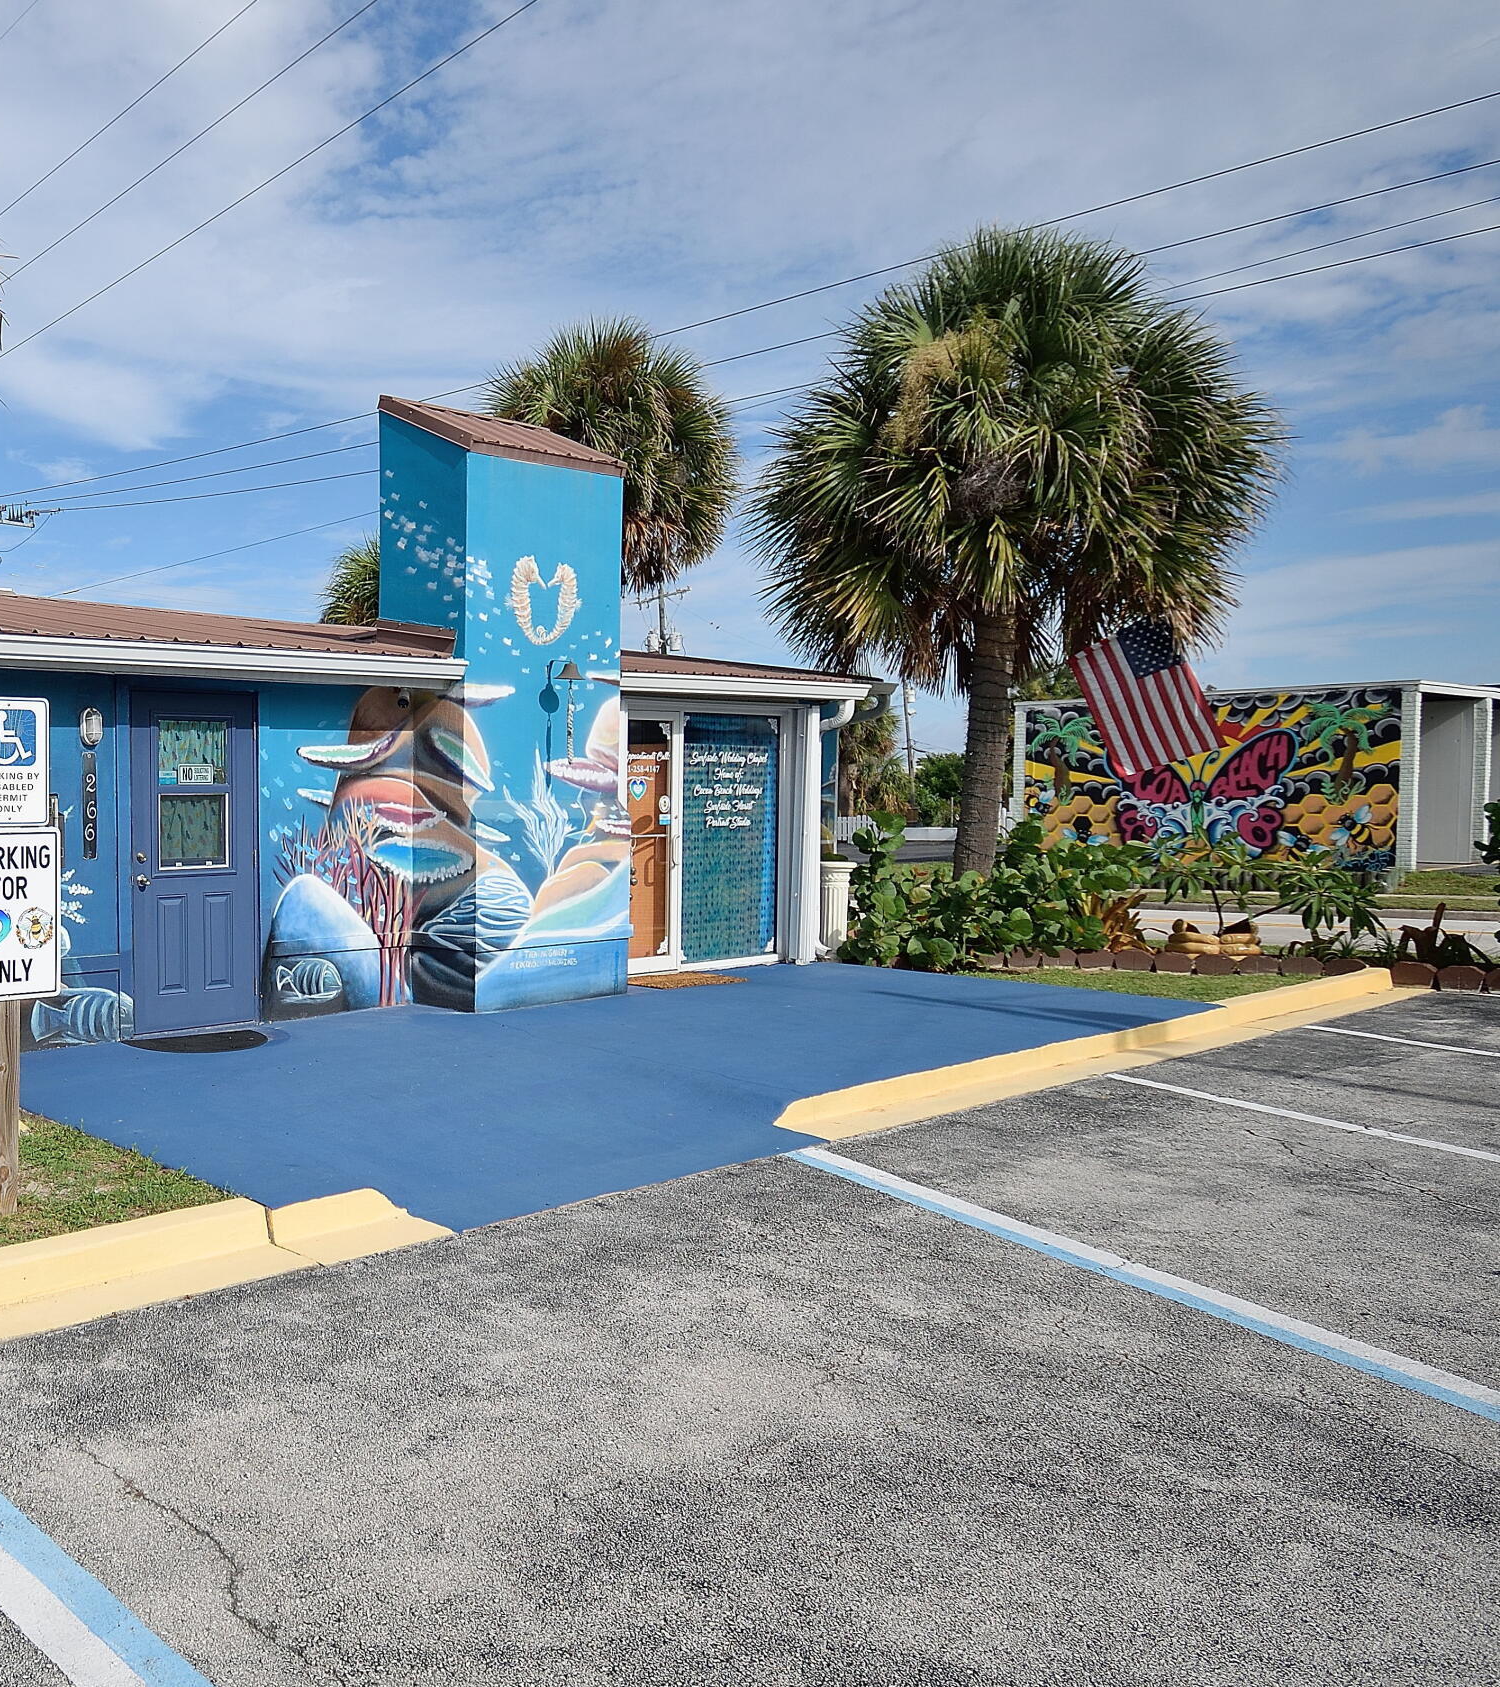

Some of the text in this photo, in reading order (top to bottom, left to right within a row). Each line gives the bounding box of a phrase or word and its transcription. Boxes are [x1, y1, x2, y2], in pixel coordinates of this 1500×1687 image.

[746, 752, 769, 766] Chapel
[182, 767, 193, 781] NO
[1211, 735, 1288, 800] BEACH
[27, 772, 40, 780] BY
[85, 773, 97, 841] 266
